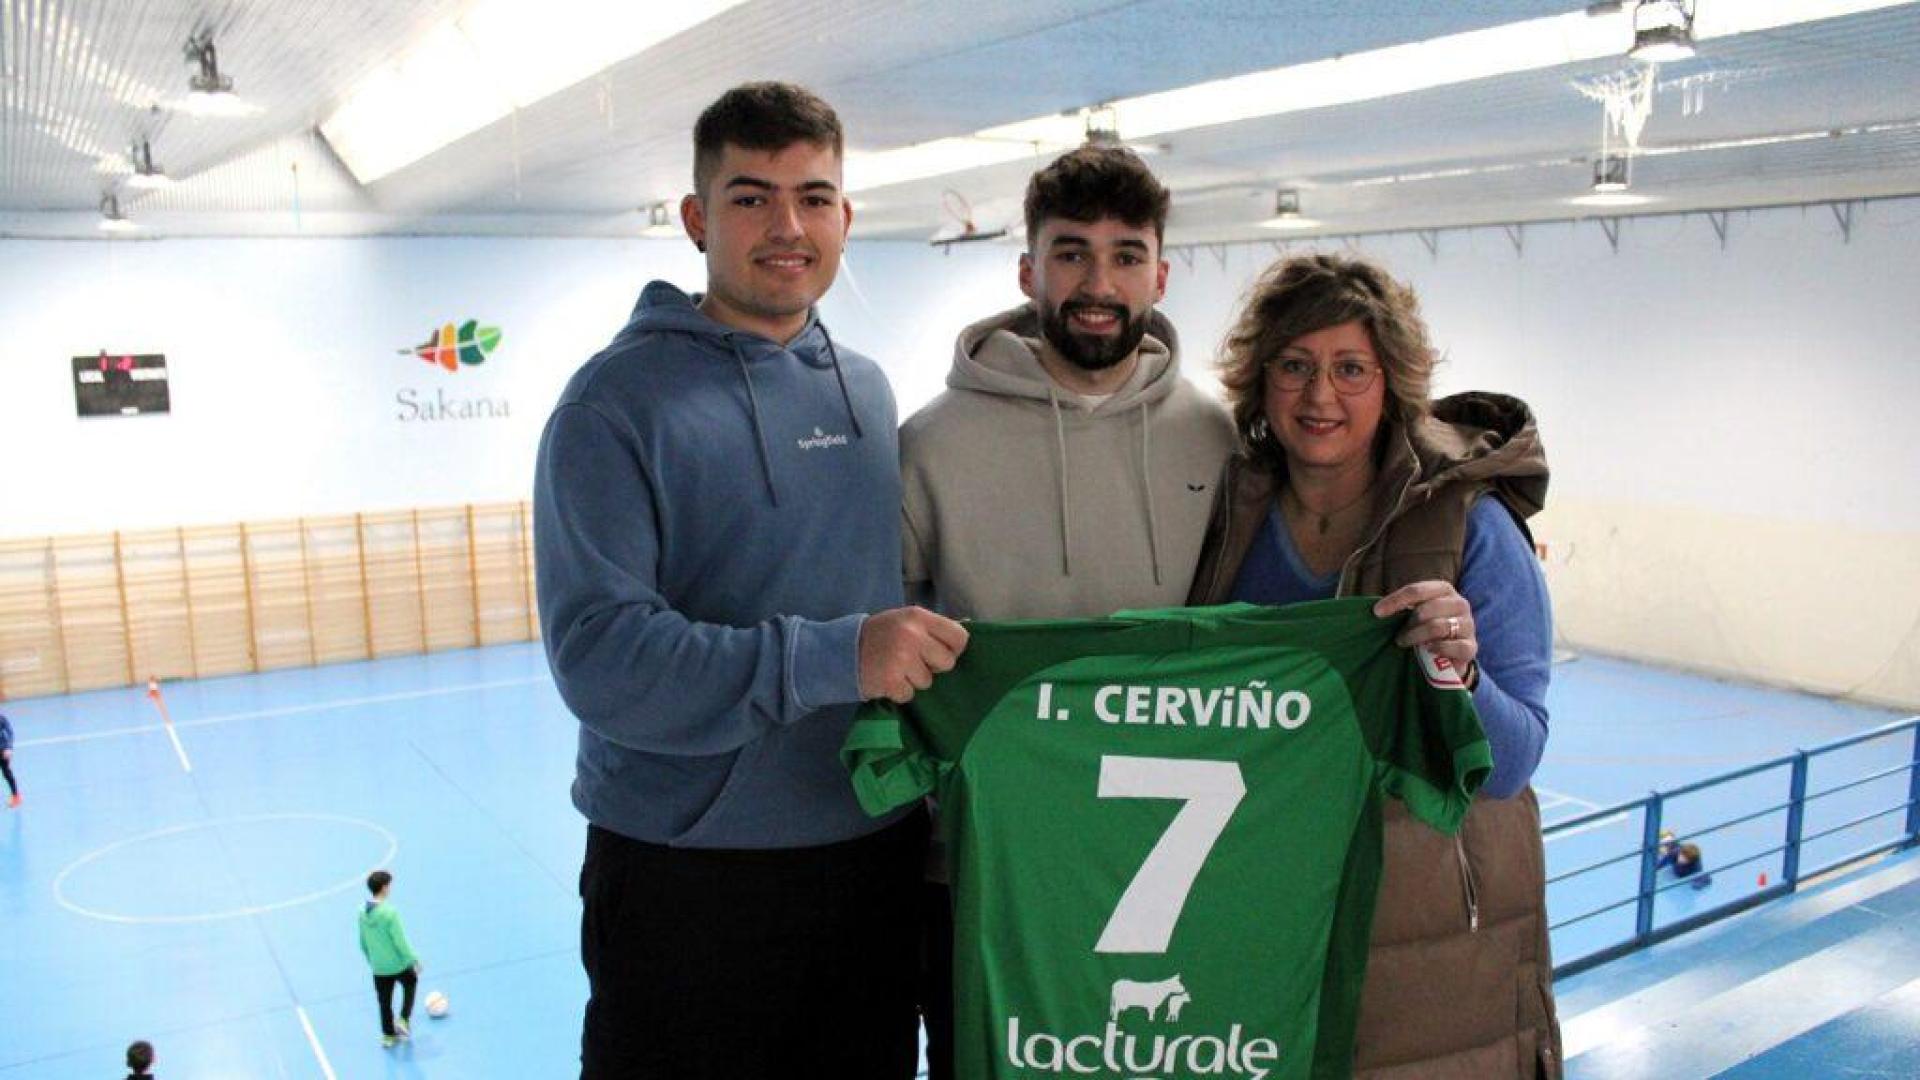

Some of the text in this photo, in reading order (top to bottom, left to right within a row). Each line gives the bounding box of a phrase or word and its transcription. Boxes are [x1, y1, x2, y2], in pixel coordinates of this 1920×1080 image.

[396, 387, 511, 421] Sakana
[1036, 682, 1070, 721] I.
[1094, 754, 1248, 954] 7
